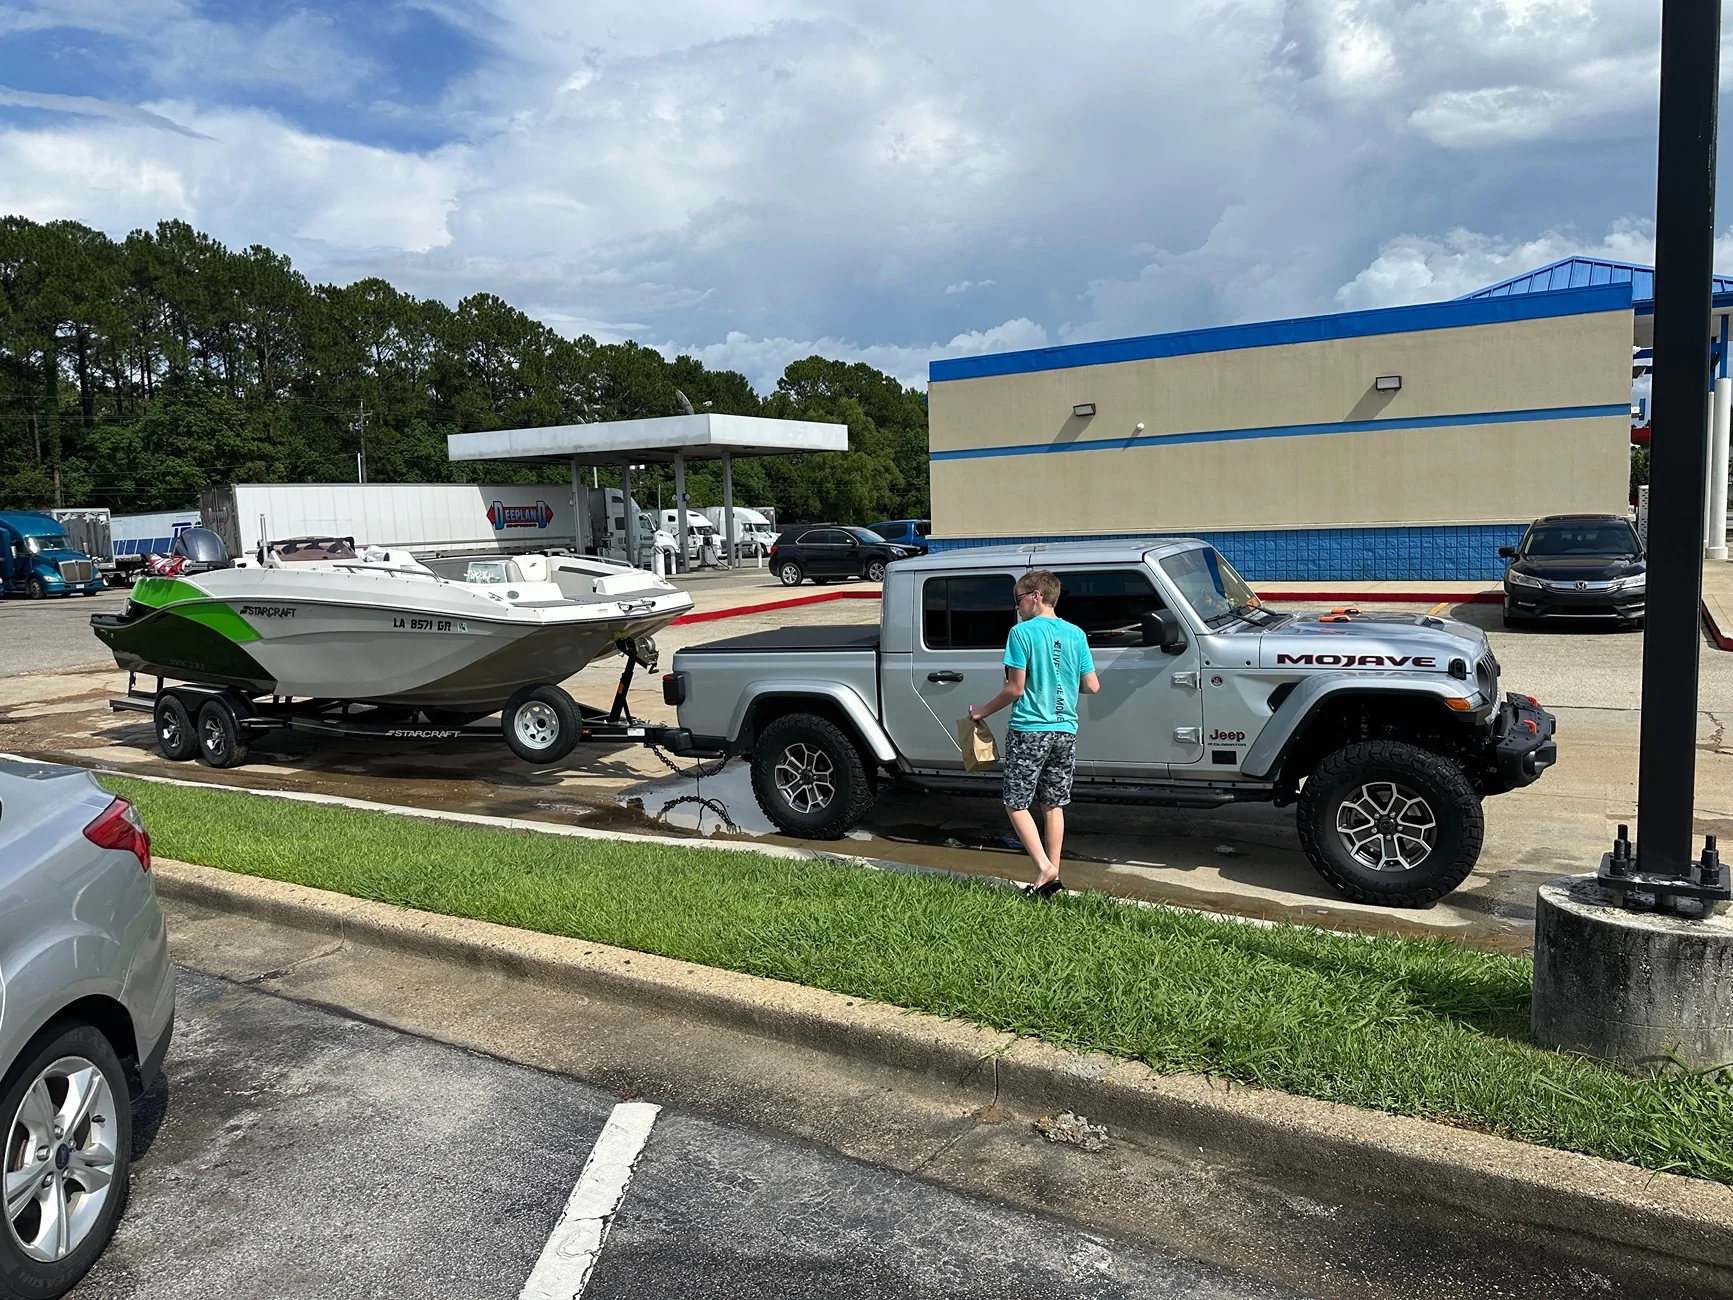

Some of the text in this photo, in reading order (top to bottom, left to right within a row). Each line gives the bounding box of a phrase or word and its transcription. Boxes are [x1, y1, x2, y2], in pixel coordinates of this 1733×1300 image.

[493, 501, 548, 530] DEEPLAND
[248, 606, 297, 618] STARCRAFT
[393, 618, 406, 629] LA
[410, 619, 433, 630] 8571
[437, 620, 452, 632] GR
[1276, 654, 1437, 668] MOJAVE
[394, 730, 461, 738] STARCRAFT
[1209, 729, 1246, 742] Jeep
